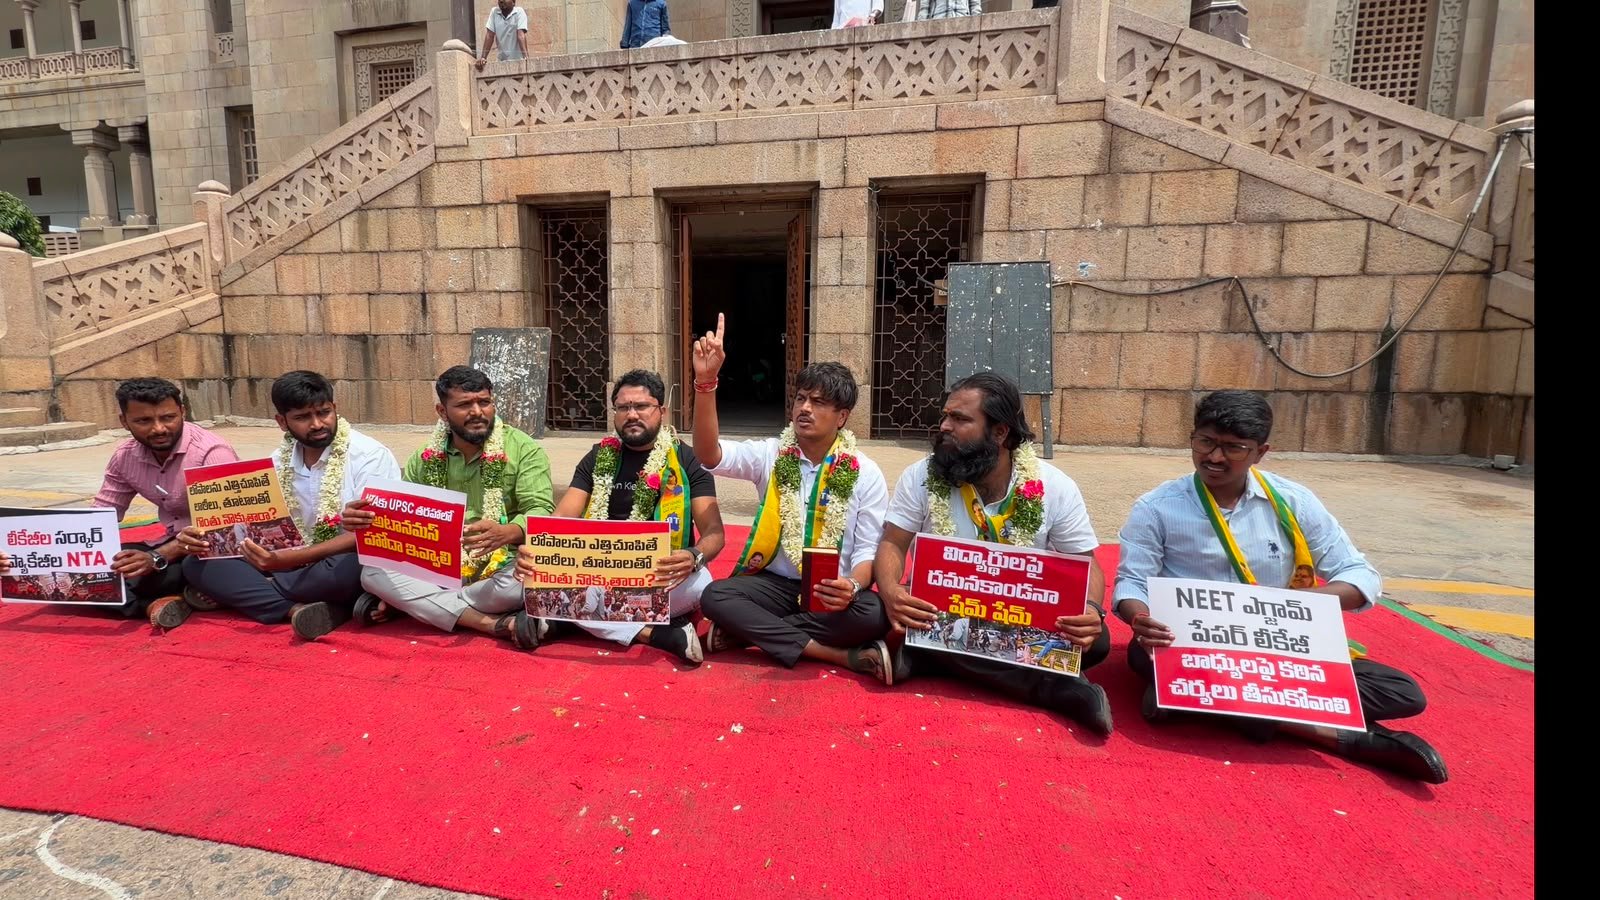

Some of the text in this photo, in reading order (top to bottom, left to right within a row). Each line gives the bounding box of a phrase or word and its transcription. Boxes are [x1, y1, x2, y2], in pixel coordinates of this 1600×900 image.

[189, 473, 271, 496] లోపాలను ఎత్తిచూపితే
[223, 490, 271, 508] తూటాలతో
[389, 498, 415, 514] UPSC
[415, 506, 454, 522] తరహాలో
[196, 507, 277, 528] గొంతు నొక్కుతారా?
[372, 515, 440, 541] అటానమస్
[7, 527, 103, 548] లీకేజీల సర్కార్
[364, 531, 452, 567] హోదా ఇవ్వాలి
[531, 532, 586, 549] లోపాలను
[589, 537, 659, 554] ఎత్తిచూపితే
[7, 550, 107, 574] ప్యాకేజీల NTA
[535, 553, 652, 569] లాఠీలు, తూటాలతో
[943, 546, 1044, 580] విద్యార్థులపై
[533, 570, 656, 591] గొంతు నొక్కుతారా?
[927, 569, 1060, 605] దమనకాండనా
[948, 594, 1032, 626] షేమ్ షేమ్
[1176, 587, 1313, 626] NEET ఎగ్జామ్
[1188, 620, 1310, 654] పేపర్ లీకేజీ
[1181, 653, 1326, 683] బాధ్యులపై కఠిన
[1168, 678, 1350, 715] చర్యలు తీసుకోవాలి
